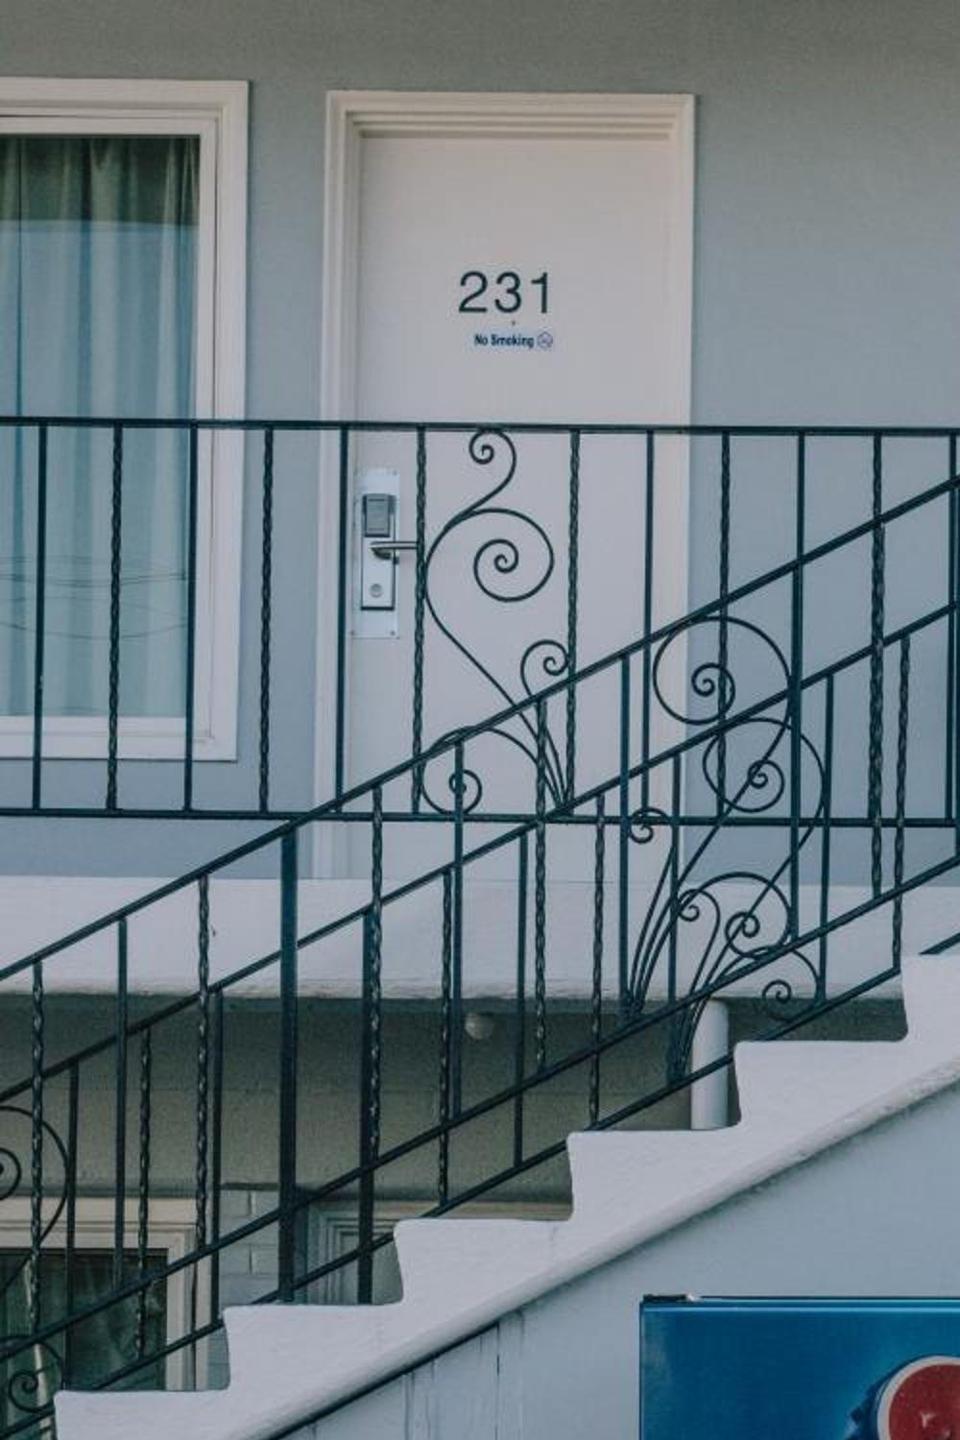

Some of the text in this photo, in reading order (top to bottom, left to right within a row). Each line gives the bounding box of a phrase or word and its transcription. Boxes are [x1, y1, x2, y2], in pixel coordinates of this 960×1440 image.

[459, 270, 548, 314] 231
[474, 333, 535, 348] No Smoking
